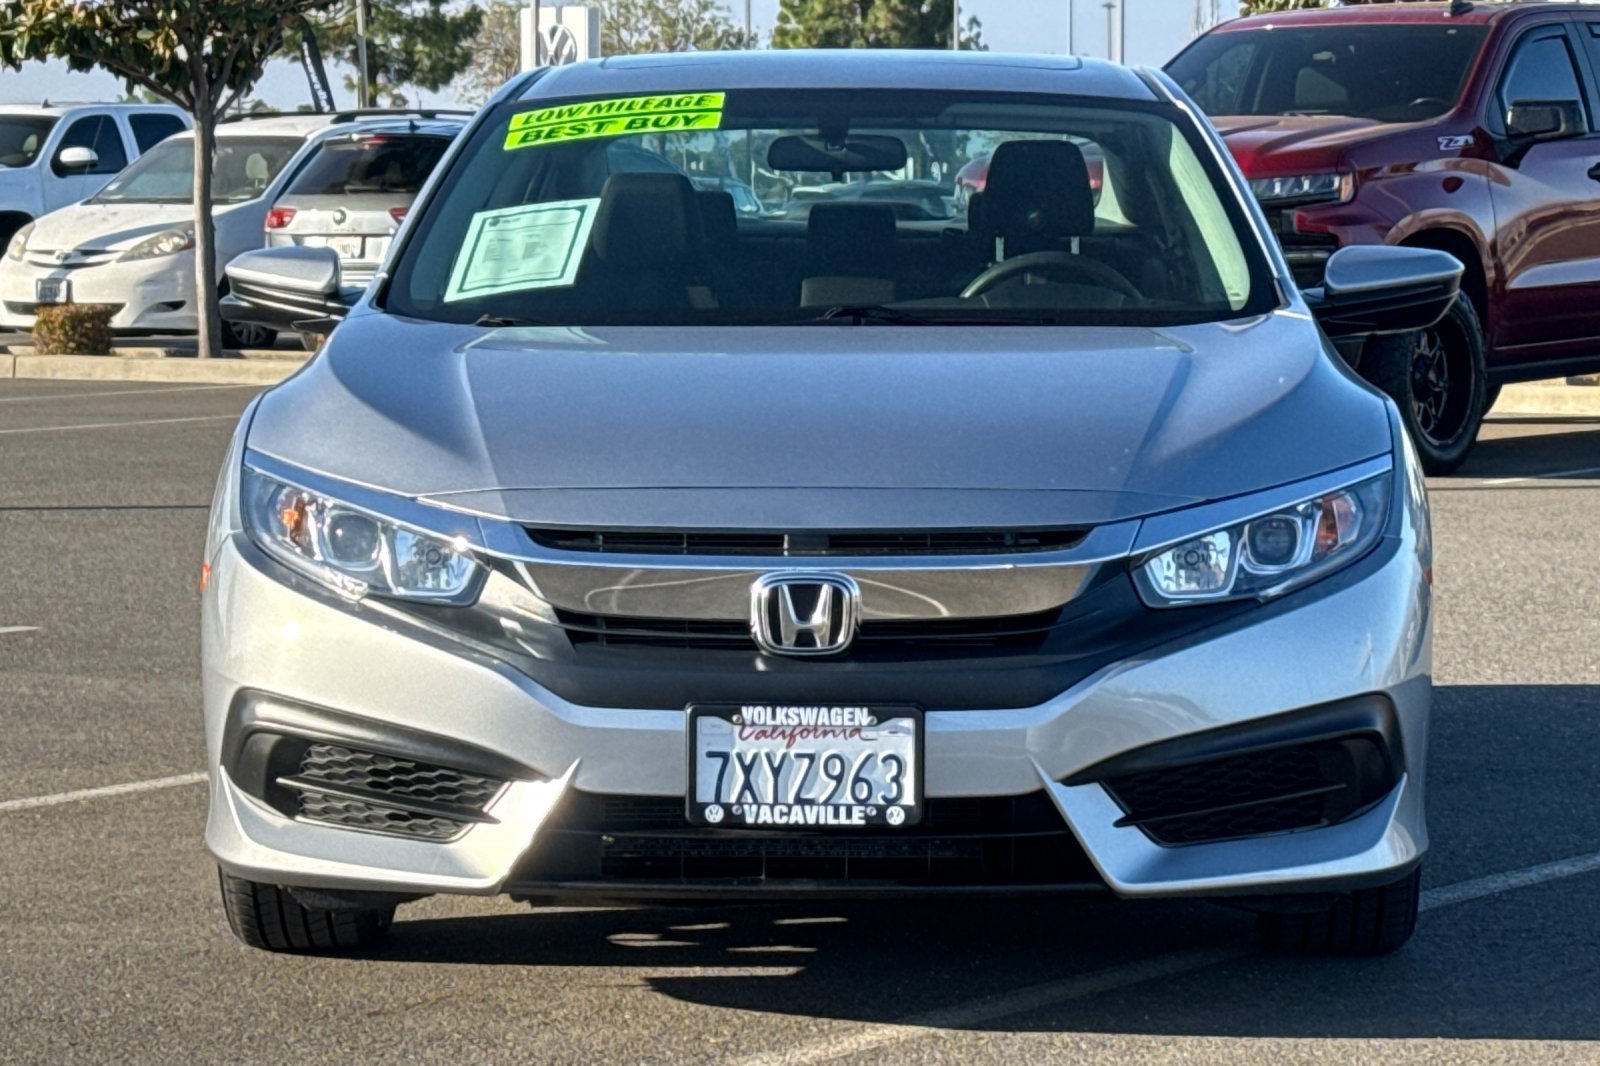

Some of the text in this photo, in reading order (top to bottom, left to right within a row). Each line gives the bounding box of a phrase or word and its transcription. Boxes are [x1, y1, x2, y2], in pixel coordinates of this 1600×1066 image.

[522, 94, 715, 126] LOW MILEAGE
[518, 114, 705, 144] BEST BUY
[741, 706, 869, 726] VOLKSWAGEN
[738, 725, 879, 747] California
[705, 751, 903, 804] 7XYZ963
[742, 804, 866, 825] VACAVILLE
